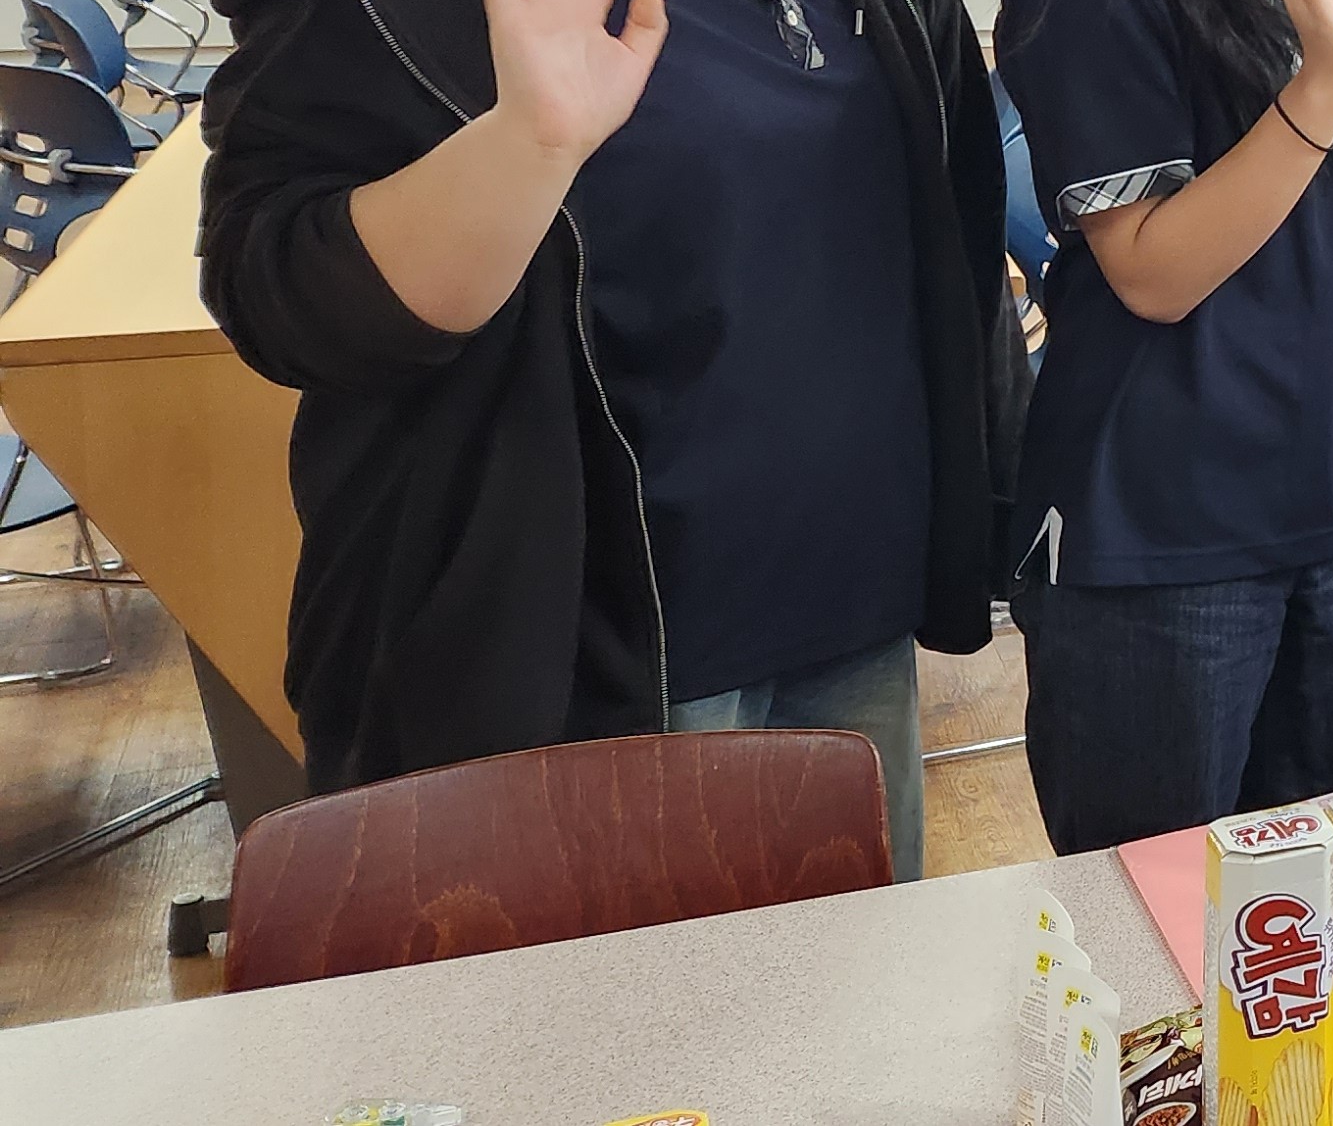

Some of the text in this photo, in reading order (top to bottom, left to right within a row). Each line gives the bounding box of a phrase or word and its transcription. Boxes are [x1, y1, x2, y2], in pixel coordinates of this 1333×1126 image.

[1232, 814, 1321, 850] 예감
[1235, 895, 1330, 1036] 예감
[1138, 1063, 1202, 1107] 게티
